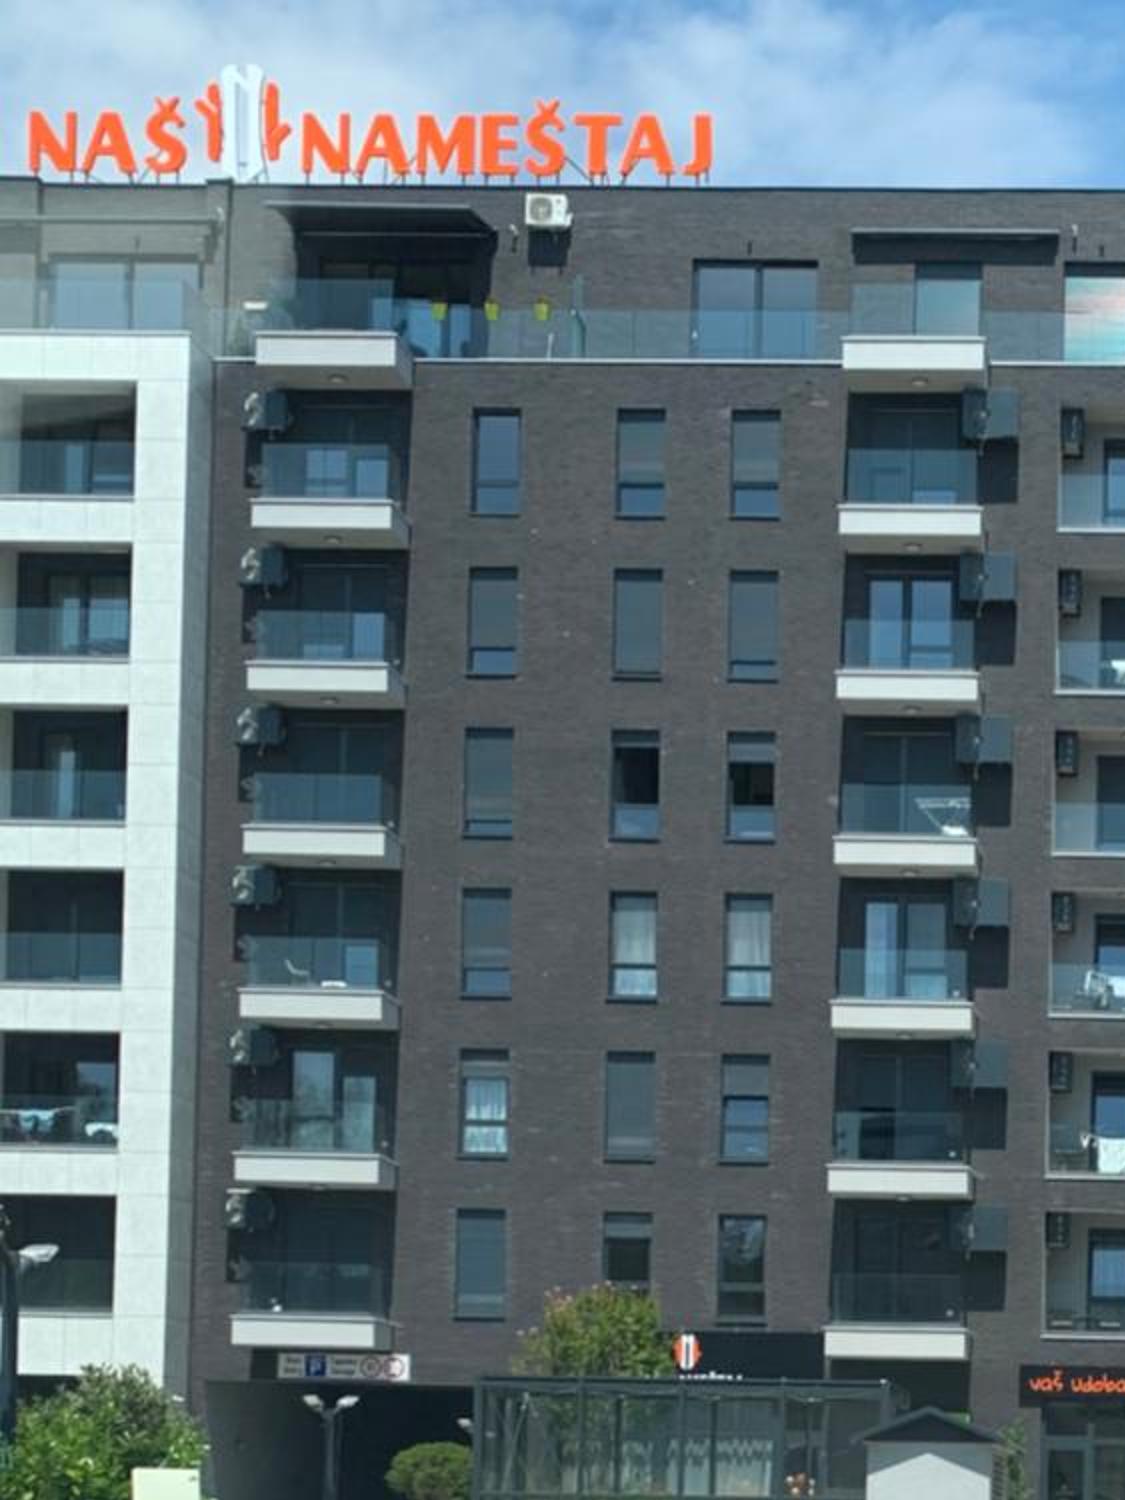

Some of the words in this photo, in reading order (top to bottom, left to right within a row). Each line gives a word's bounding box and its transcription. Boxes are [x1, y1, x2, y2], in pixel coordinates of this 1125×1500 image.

[28, 97, 187, 174] NAŠ
[301, 98, 713, 176] NAMEŠTAJ
[1029, 1370, 1064, 1392] vaš
